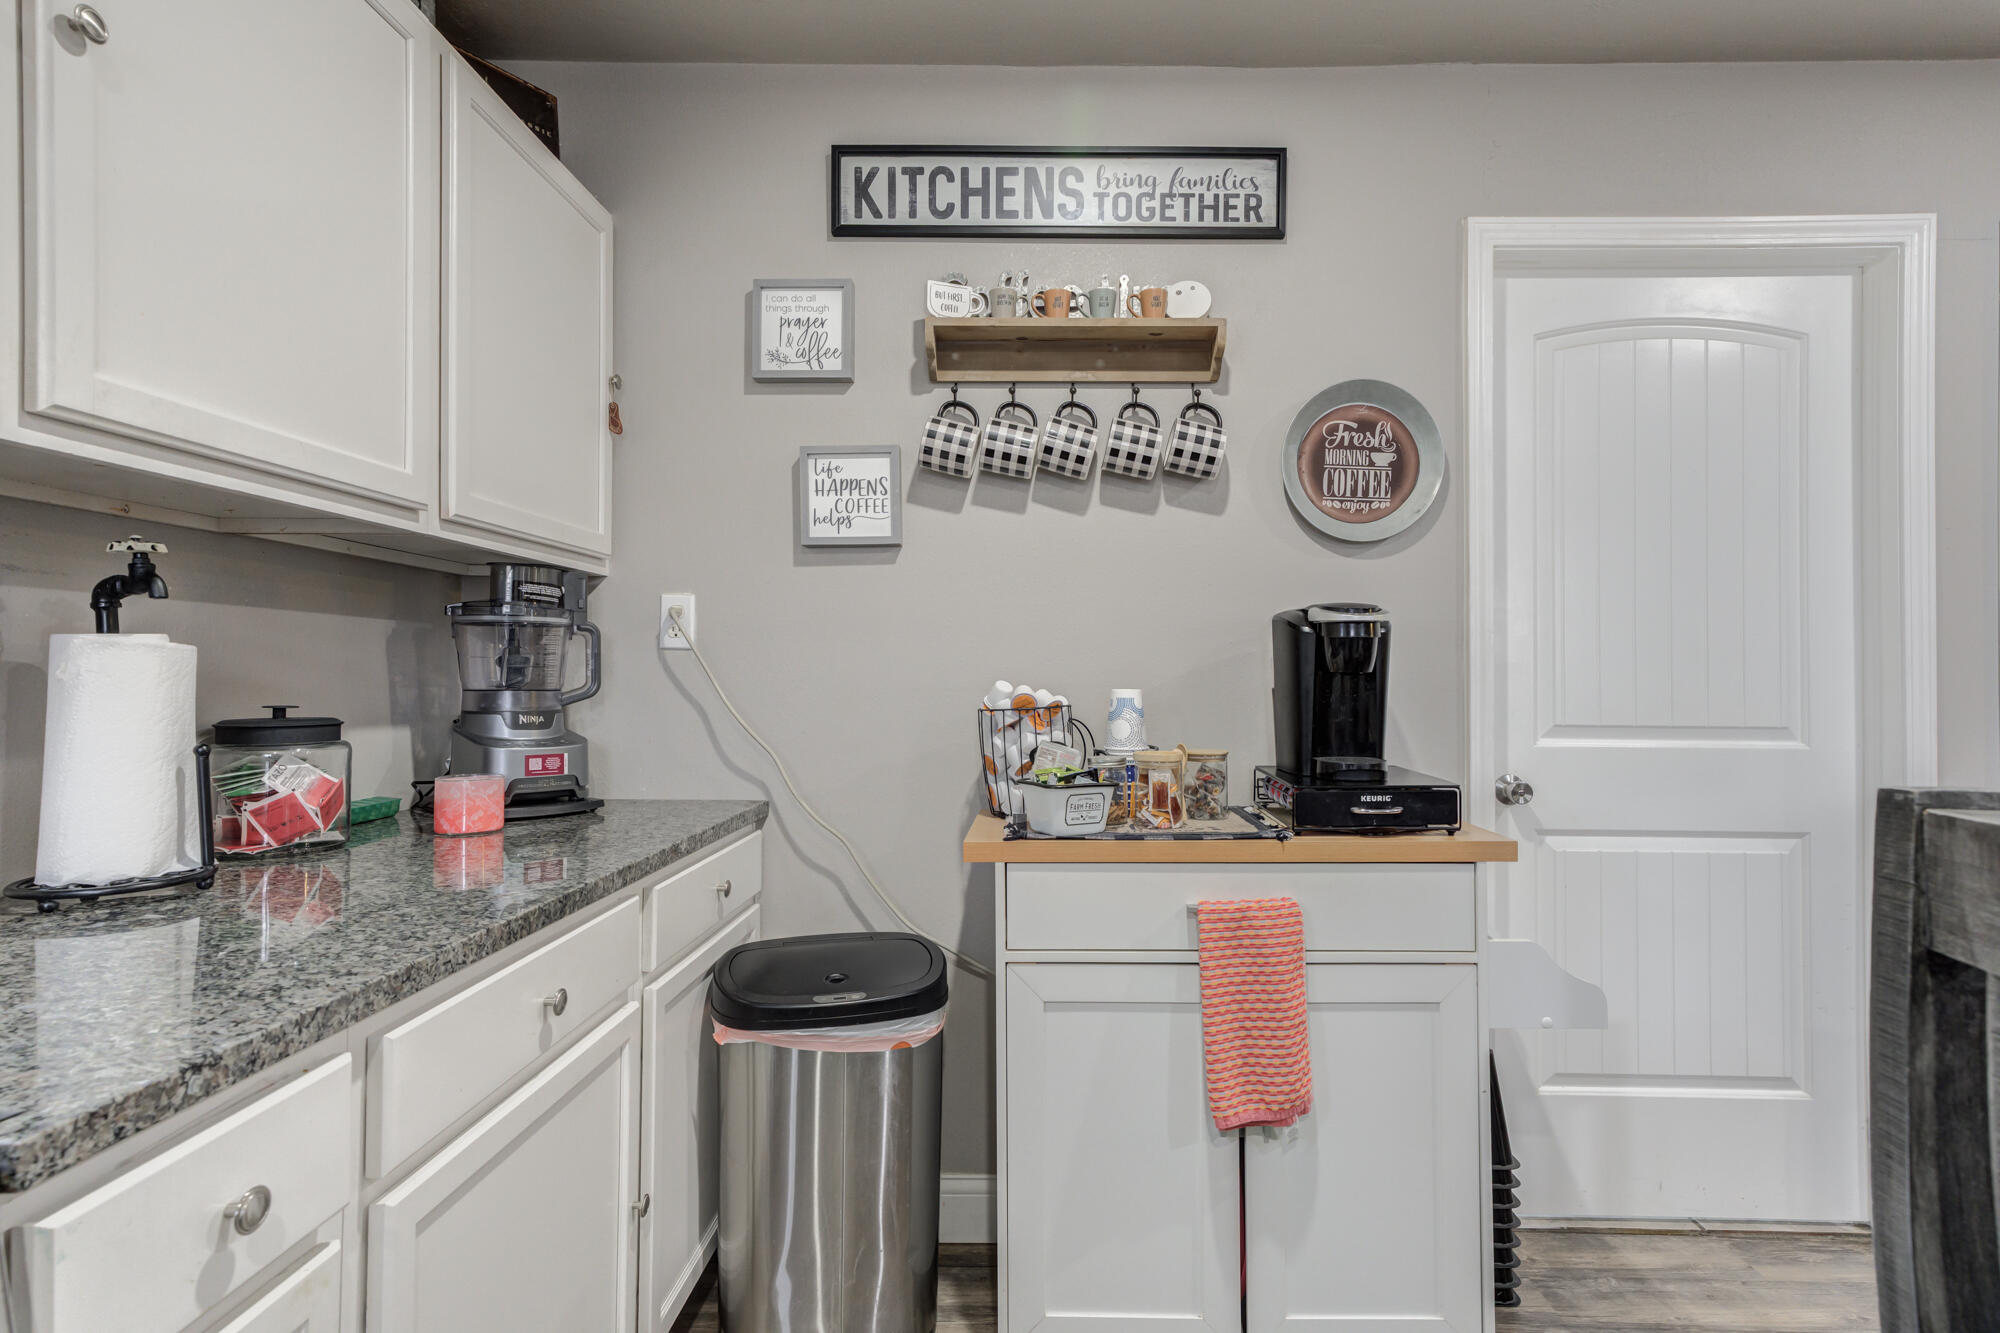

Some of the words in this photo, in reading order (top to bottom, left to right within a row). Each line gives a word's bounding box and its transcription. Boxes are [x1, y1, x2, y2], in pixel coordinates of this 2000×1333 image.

[854, 166, 1085, 220] KITCHENS
[1096, 164, 1162, 202] bring
[1168, 166, 1260, 202] families
[1092, 191, 1264, 223] TOGETHER
[766, 304, 792, 314] things
[795, 304, 830, 314] through
[791, 294, 803, 303] do
[806, 294, 817, 303] all
[779, 315, 828, 347] prayer
[785, 332, 794, 349] &
[795, 331, 842, 370] coffee
[1323, 420, 1387, 449] Fresh
[814, 457, 844, 479] life
[1325, 449, 1369, 466] MORNING
[814, 476, 889, 497] HAPPENS
[1322, 467, 1392, 498] COFFEE
[834, 497, 890, 514] COFFEE
[1342, 500, 1370, 514] enjoy
[813, 507, 858, 535] helps
